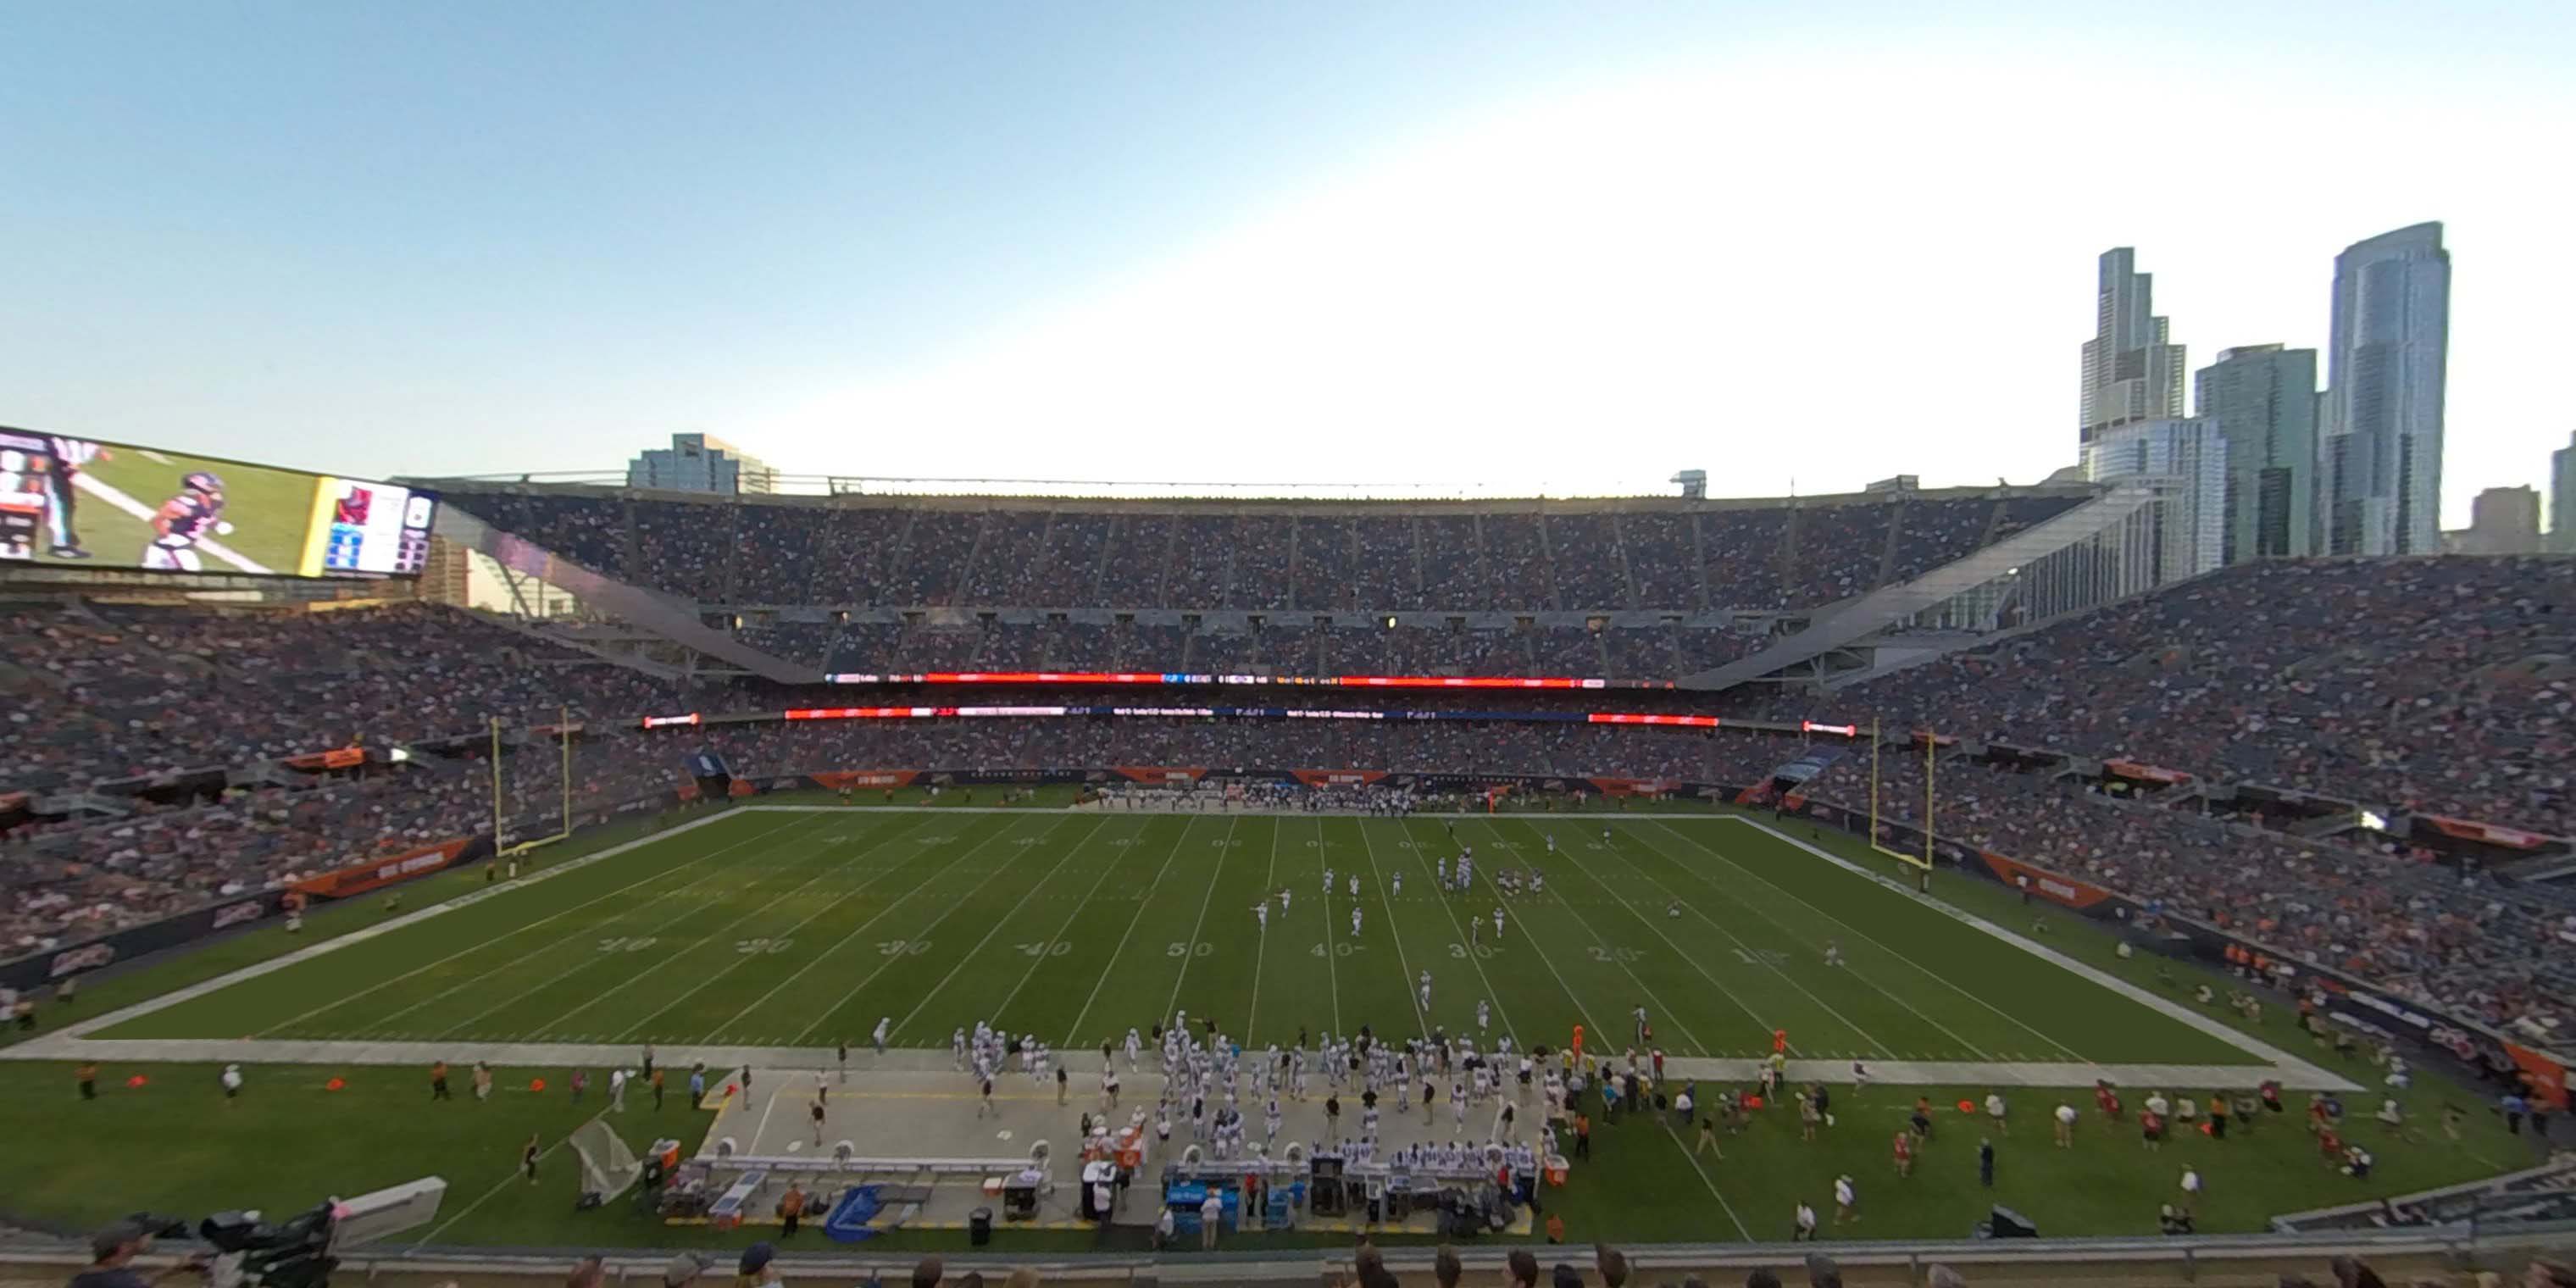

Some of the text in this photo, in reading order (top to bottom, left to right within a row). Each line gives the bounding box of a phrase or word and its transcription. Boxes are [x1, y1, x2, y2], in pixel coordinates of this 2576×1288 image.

[1167, 943, 1213, 956] 50
[1310, 943, 1353, 957] 40
[1448, 943, 1492, 959] 30
